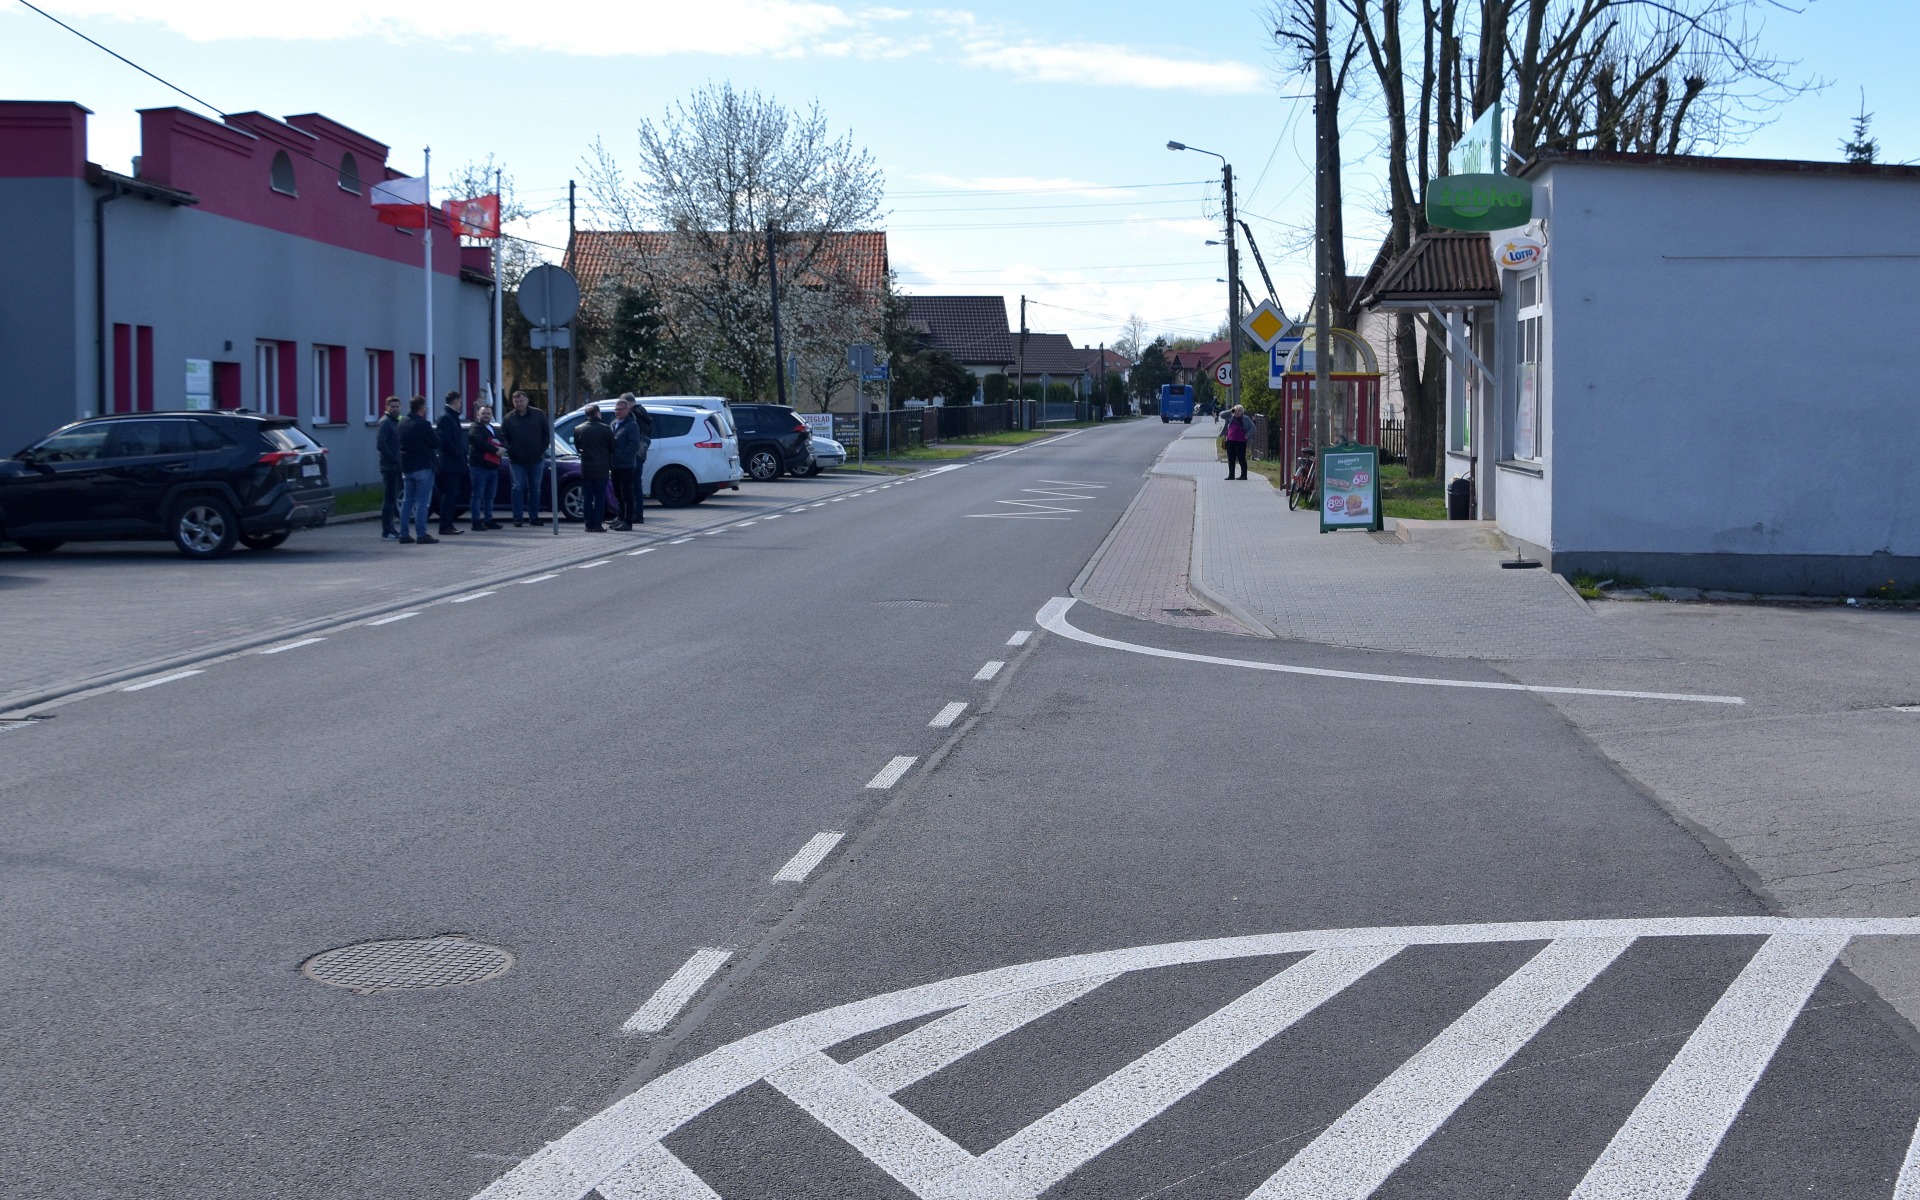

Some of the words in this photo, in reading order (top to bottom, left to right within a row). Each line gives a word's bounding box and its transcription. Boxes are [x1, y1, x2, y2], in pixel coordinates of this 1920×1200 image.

[1509, 249, 1533, 262] LOTTO
[1219, 368, 1232, 380] 3
[803, 415, 830, 424] RZEGLĄD
